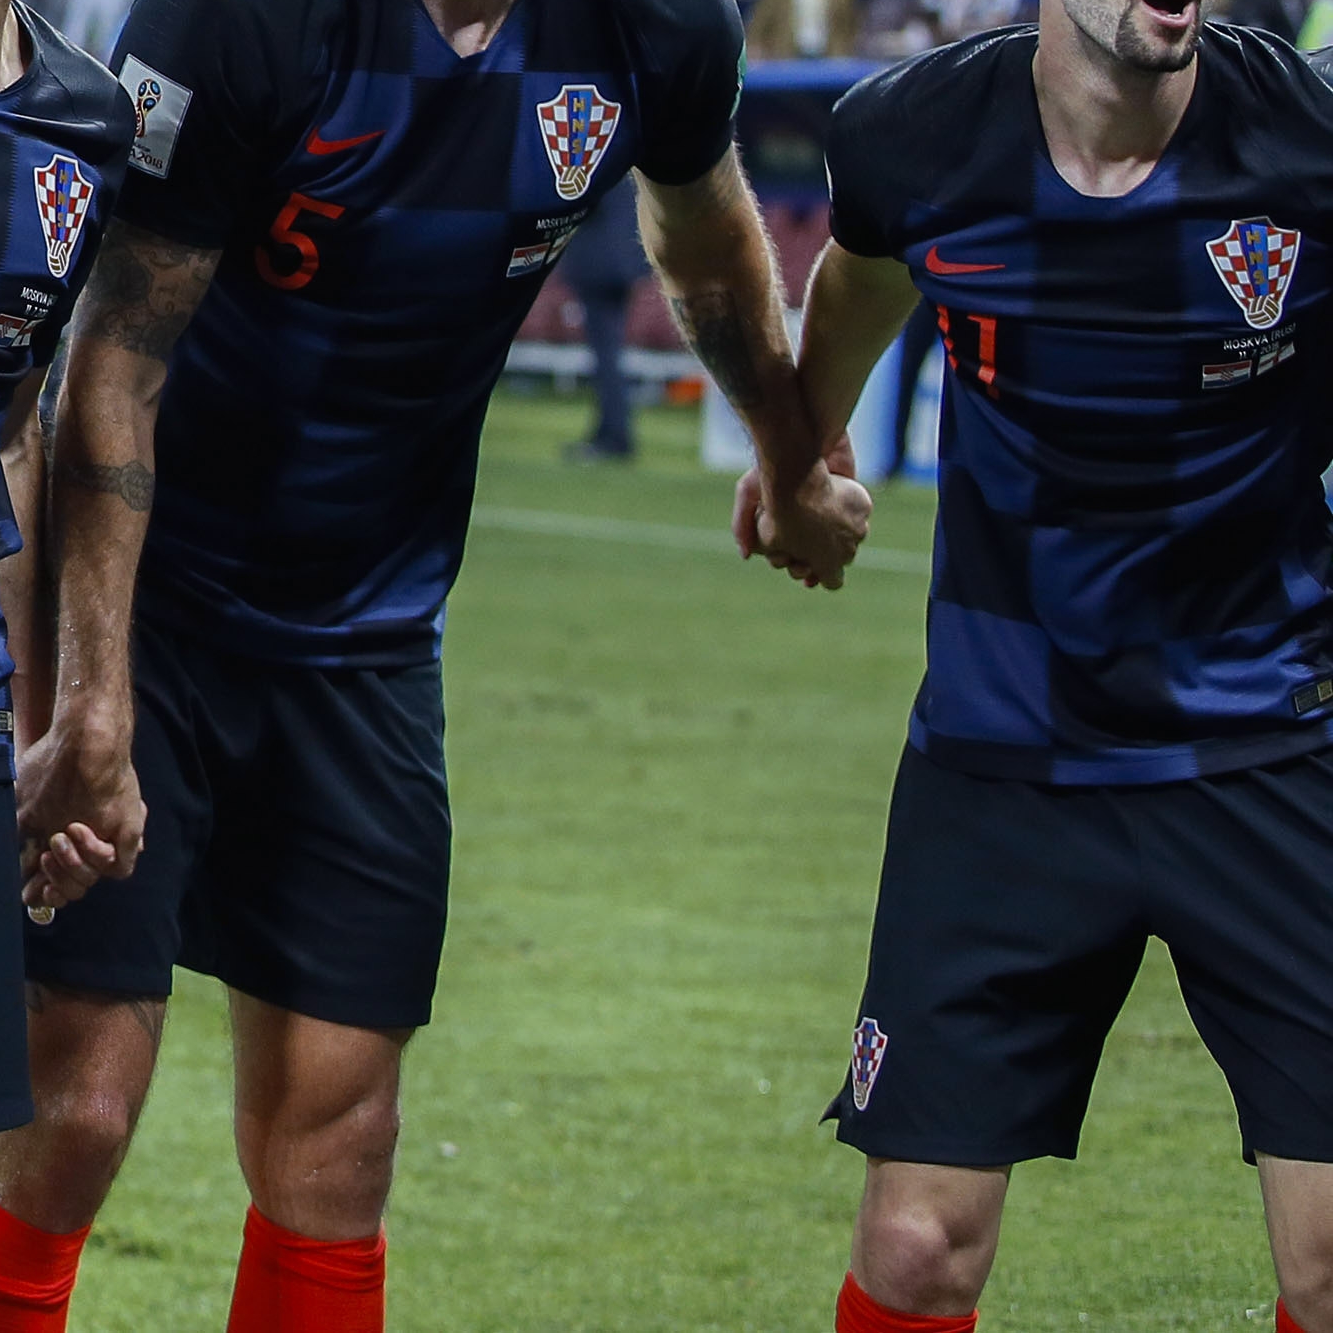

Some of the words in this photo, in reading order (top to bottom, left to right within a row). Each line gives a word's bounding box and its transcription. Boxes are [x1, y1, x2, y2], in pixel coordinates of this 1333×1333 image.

[136, 152, 163, 169] 2018
[254, 192, 346, 289] 5
[1223, 333, 1270, 351] MOSKVA
